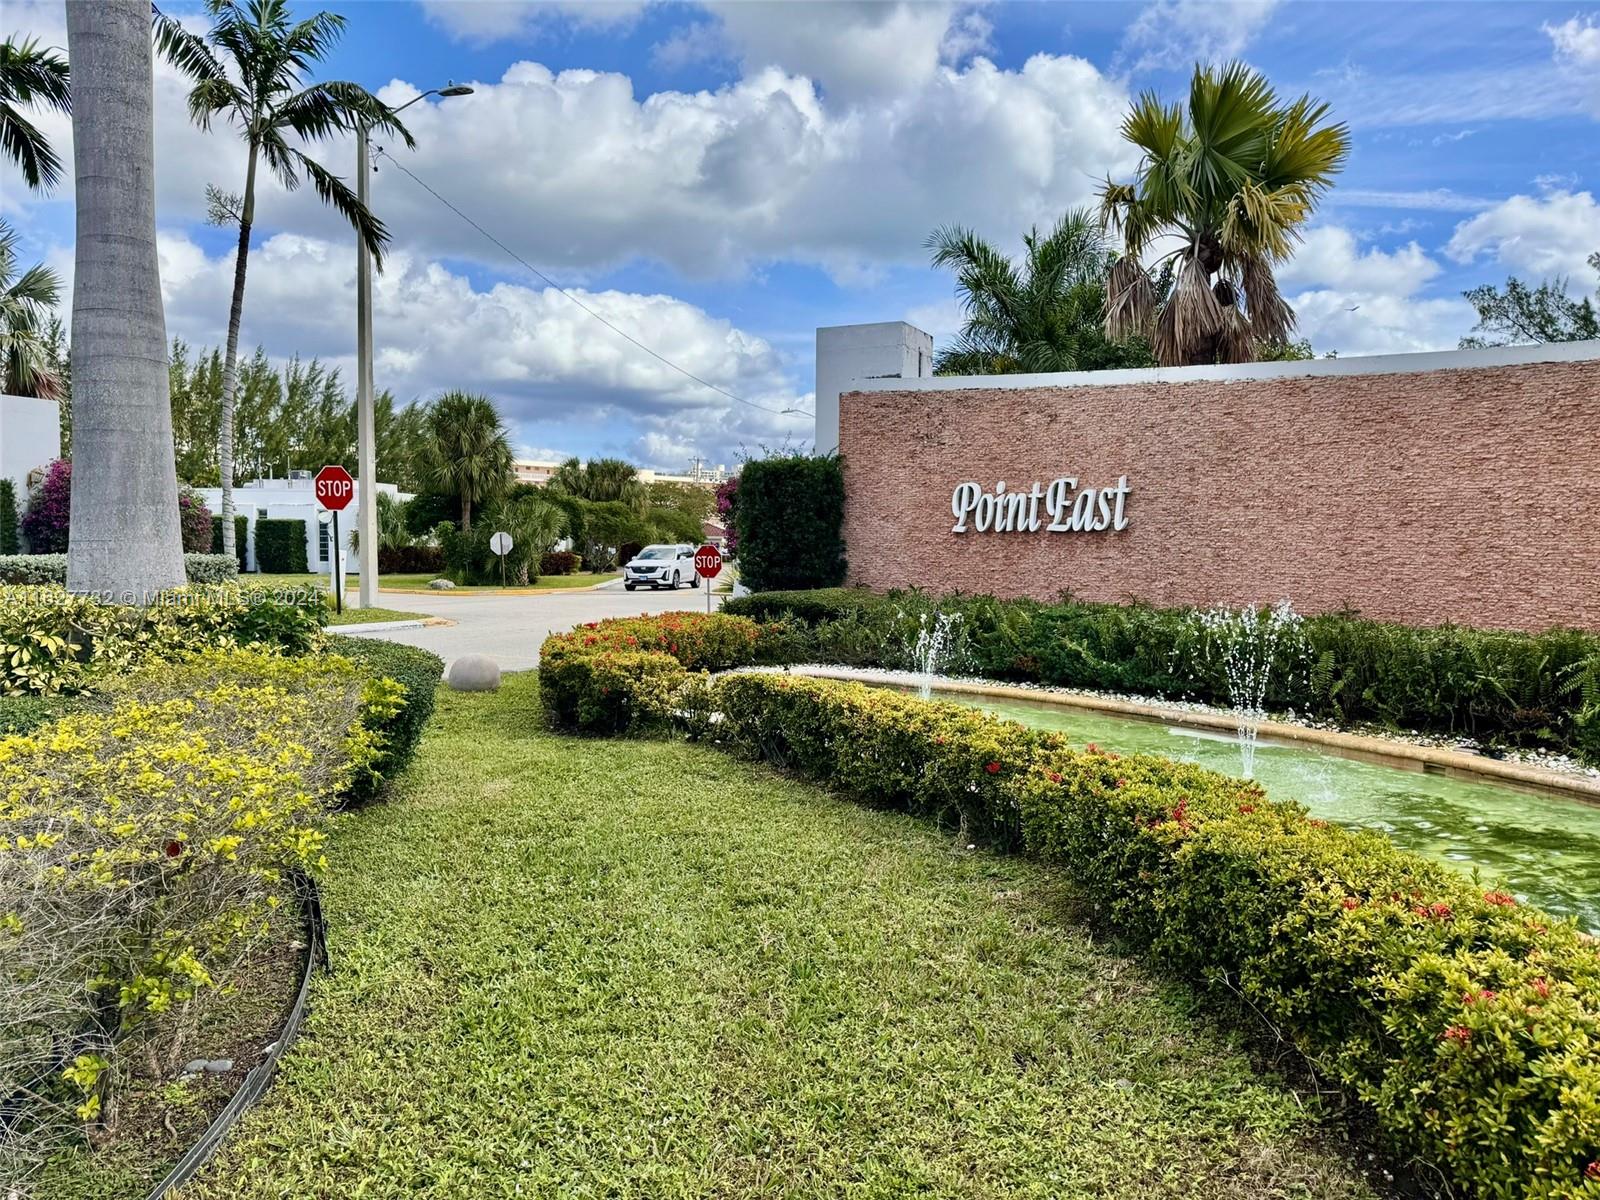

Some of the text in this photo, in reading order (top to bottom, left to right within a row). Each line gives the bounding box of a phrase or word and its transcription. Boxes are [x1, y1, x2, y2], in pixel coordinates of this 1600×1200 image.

[318, 480, 350, 497] STOP
[952, 475, 1131, 533] Point East
[695, 555, 720, 568] STOP
